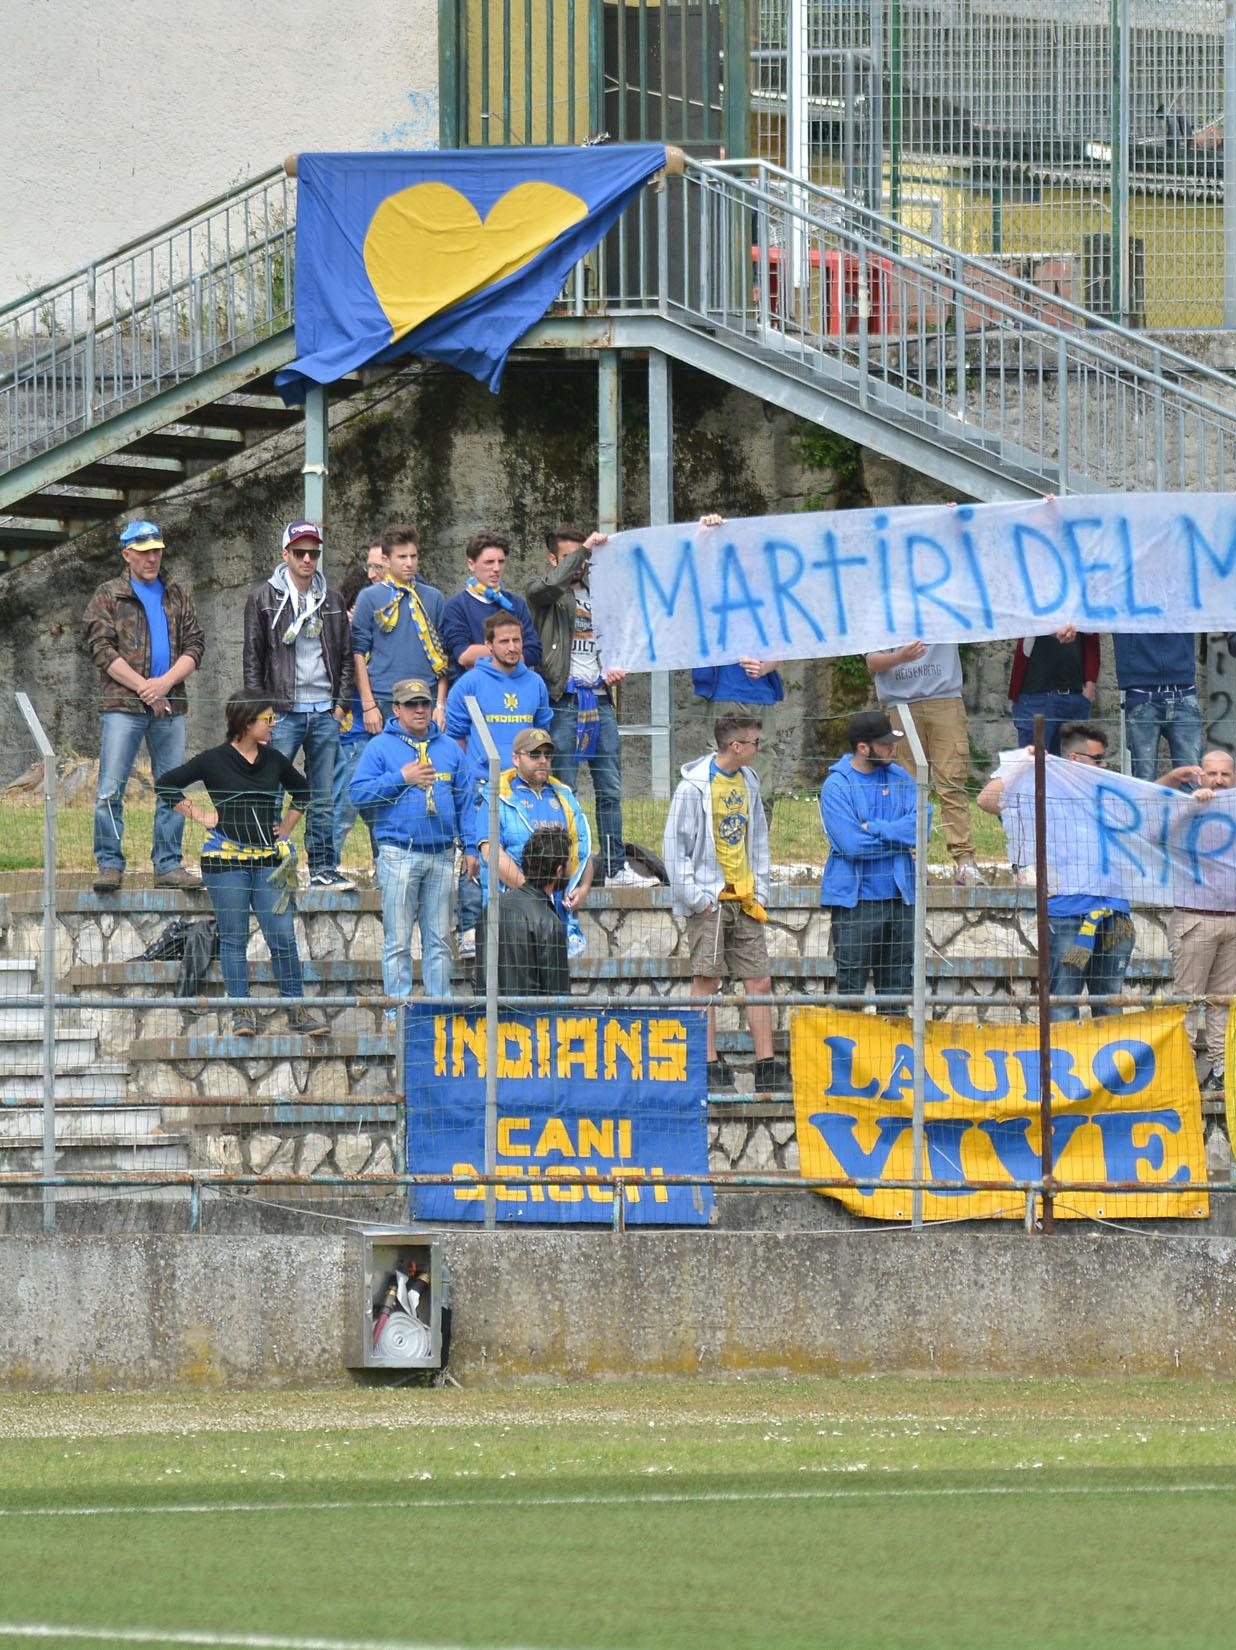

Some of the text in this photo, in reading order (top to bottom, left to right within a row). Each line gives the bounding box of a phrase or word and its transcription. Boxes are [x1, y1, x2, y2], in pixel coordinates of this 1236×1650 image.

[1013, 516, 1163, 619] DEL
[434, 1014, 687, 1082] INDIANS
[823, 1035, 1155, 1102] LAURO
[497, 1117, 632, 1158] CANI
[808, 1108, 1191, 1197] VIVE
